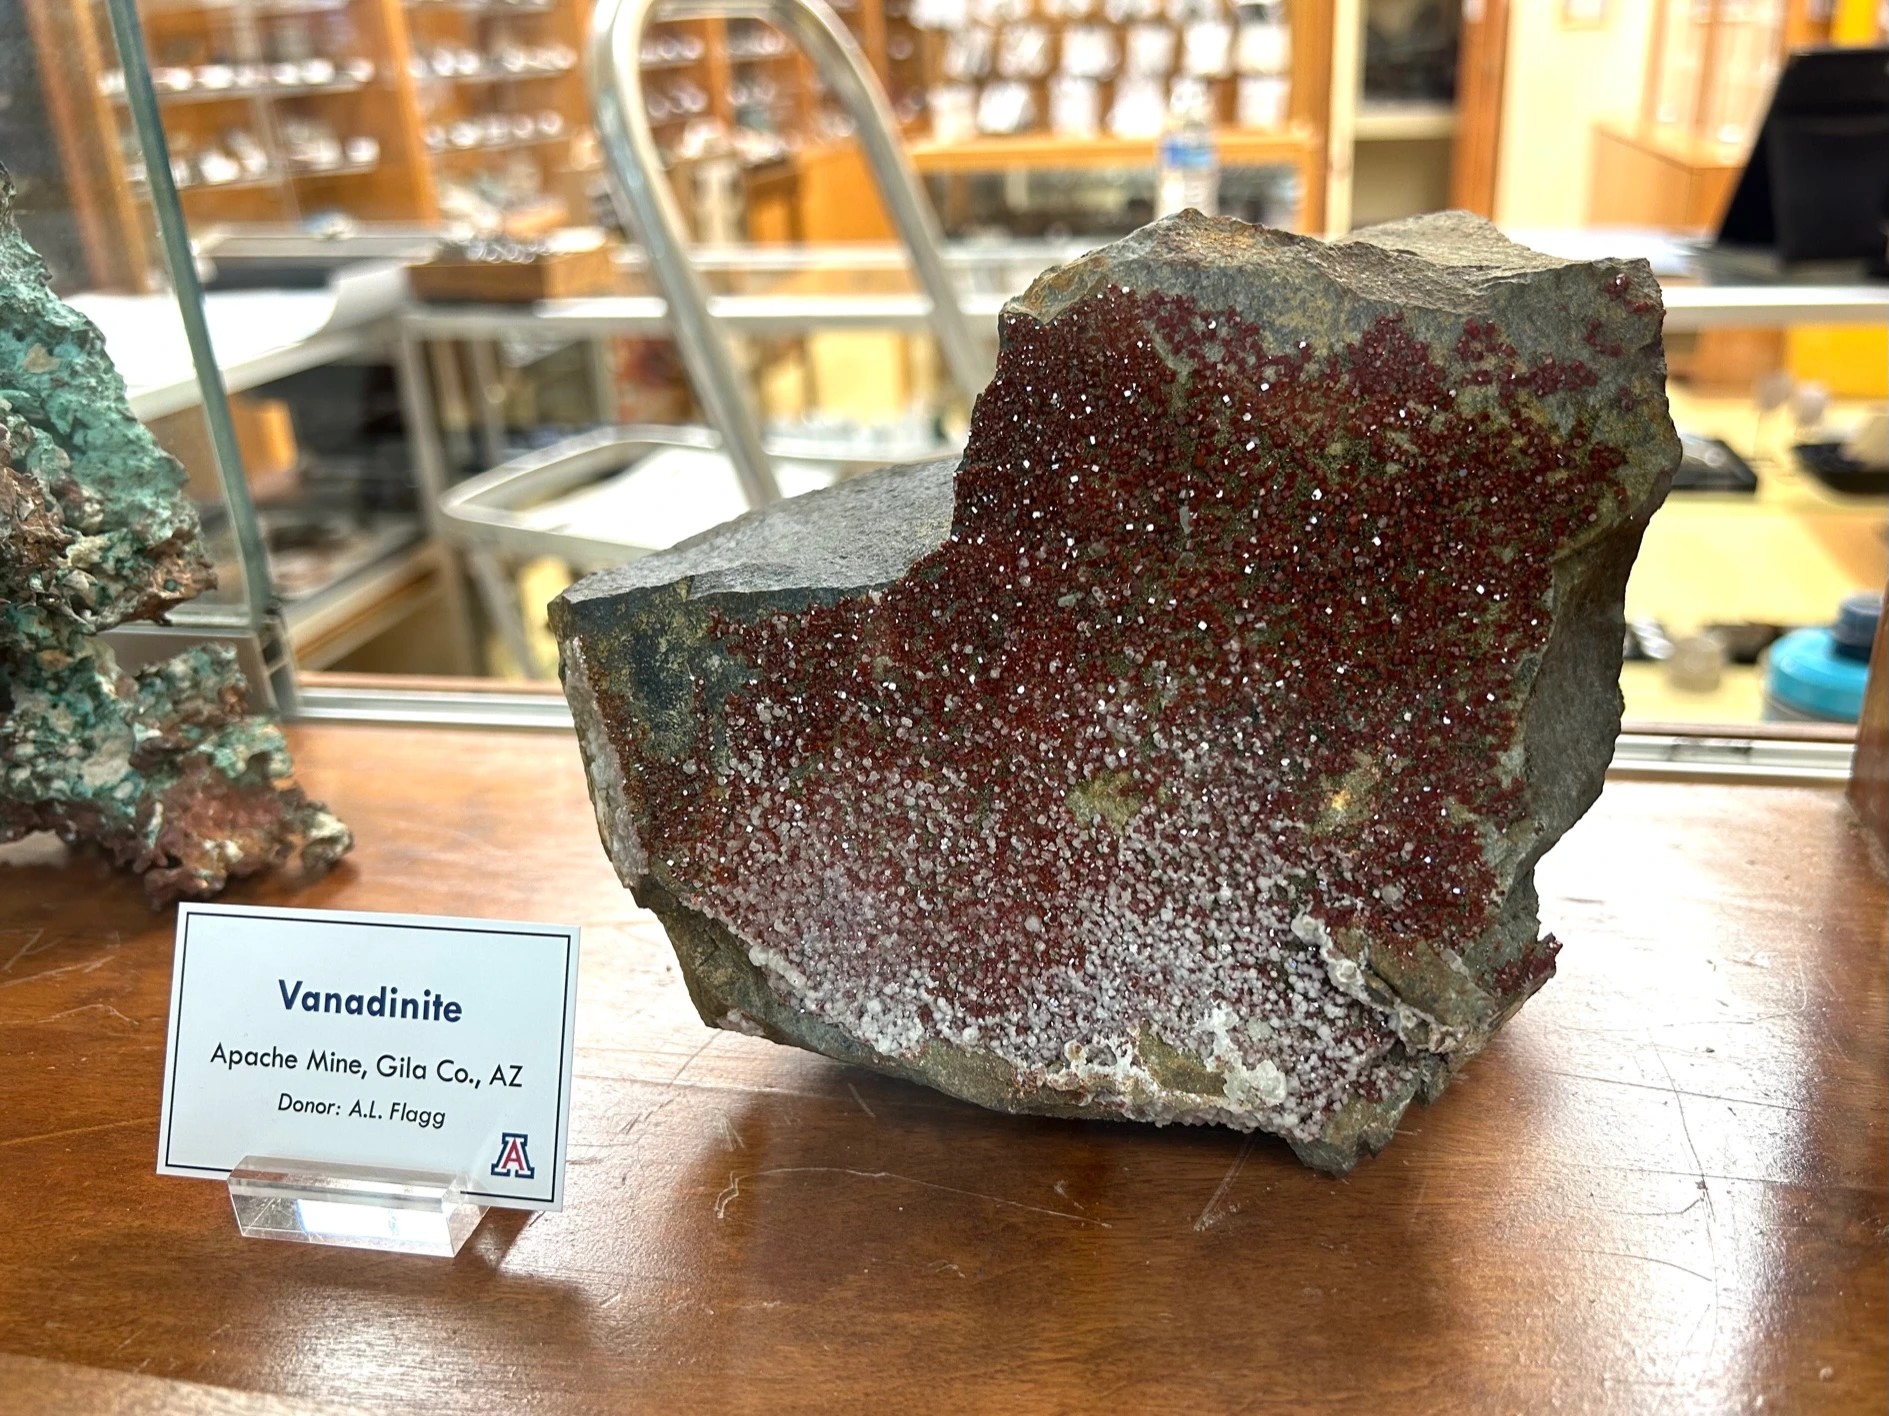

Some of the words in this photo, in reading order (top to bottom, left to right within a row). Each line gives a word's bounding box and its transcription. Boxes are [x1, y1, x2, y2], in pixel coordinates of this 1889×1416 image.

[279, 980, 462, 1022] Vanadinite
[210, 1043, 297, 1070] Apache
[307, 1050, 367, 1079] Mine,
[377, 1055, 426, 1079] Gila
[437, 1060, 480, 1089] Co.,
[489, 1064, 523, 1087] AZ
[278, 1093, 340, 1115] Donor:
[349, 1099, 382, 1119] A.L.
[390, 1102, 445, 1129] Flagg
[491, 1132, 535, 1179] A
